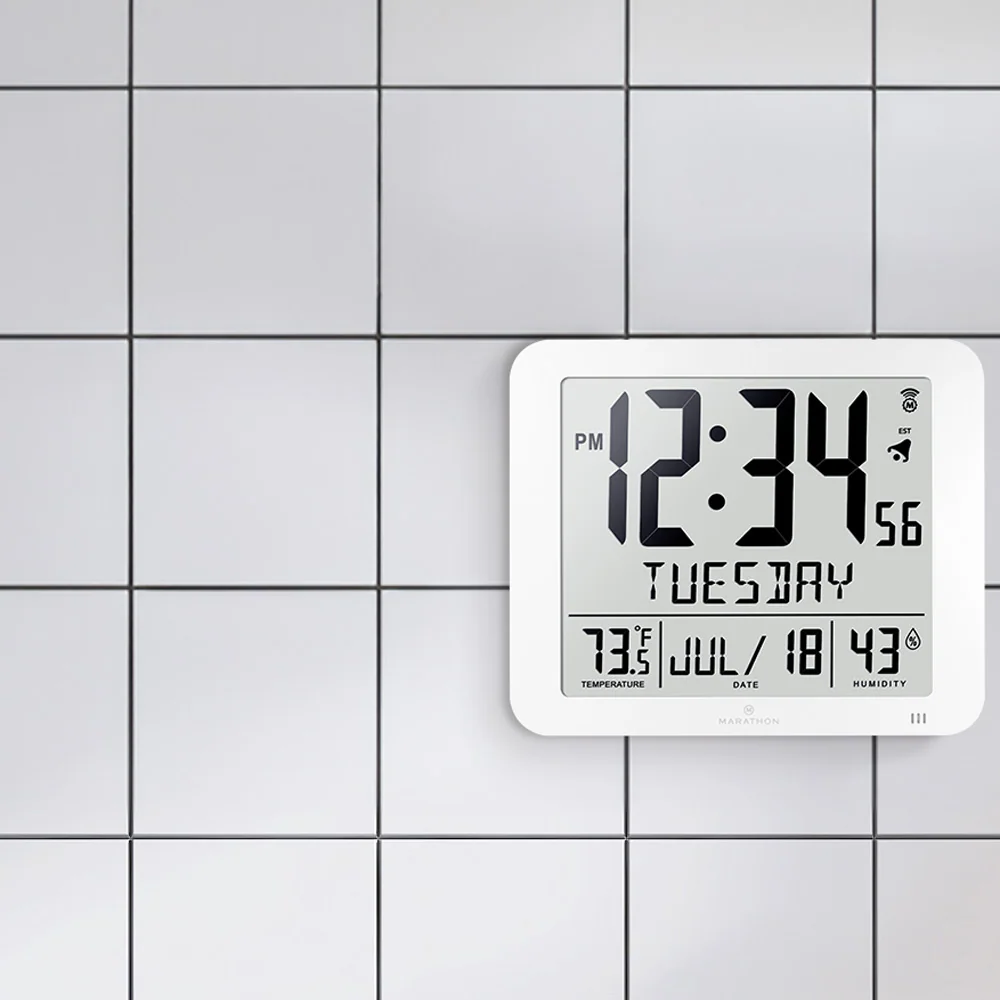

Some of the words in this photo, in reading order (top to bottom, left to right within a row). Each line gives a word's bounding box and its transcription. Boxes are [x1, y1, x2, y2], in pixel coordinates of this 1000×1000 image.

[898, 427, 912, 435] EST
[575, 432, 604, 451] PM
[607, 388, 868, 547] 12:34
[875, 501, 923, 547] 56
[642, 561, 854, 605] TUESDAY
[786, 628, 823, 676] 18
[850, 627, 900, 675] 43
[580, 680, 645, 689] TEMPERATURE
[732, 680, 760, 689] DATE
[852, 679, 908, 688] HUMIDITY
[718, 716, 780, 725] MARATHON
